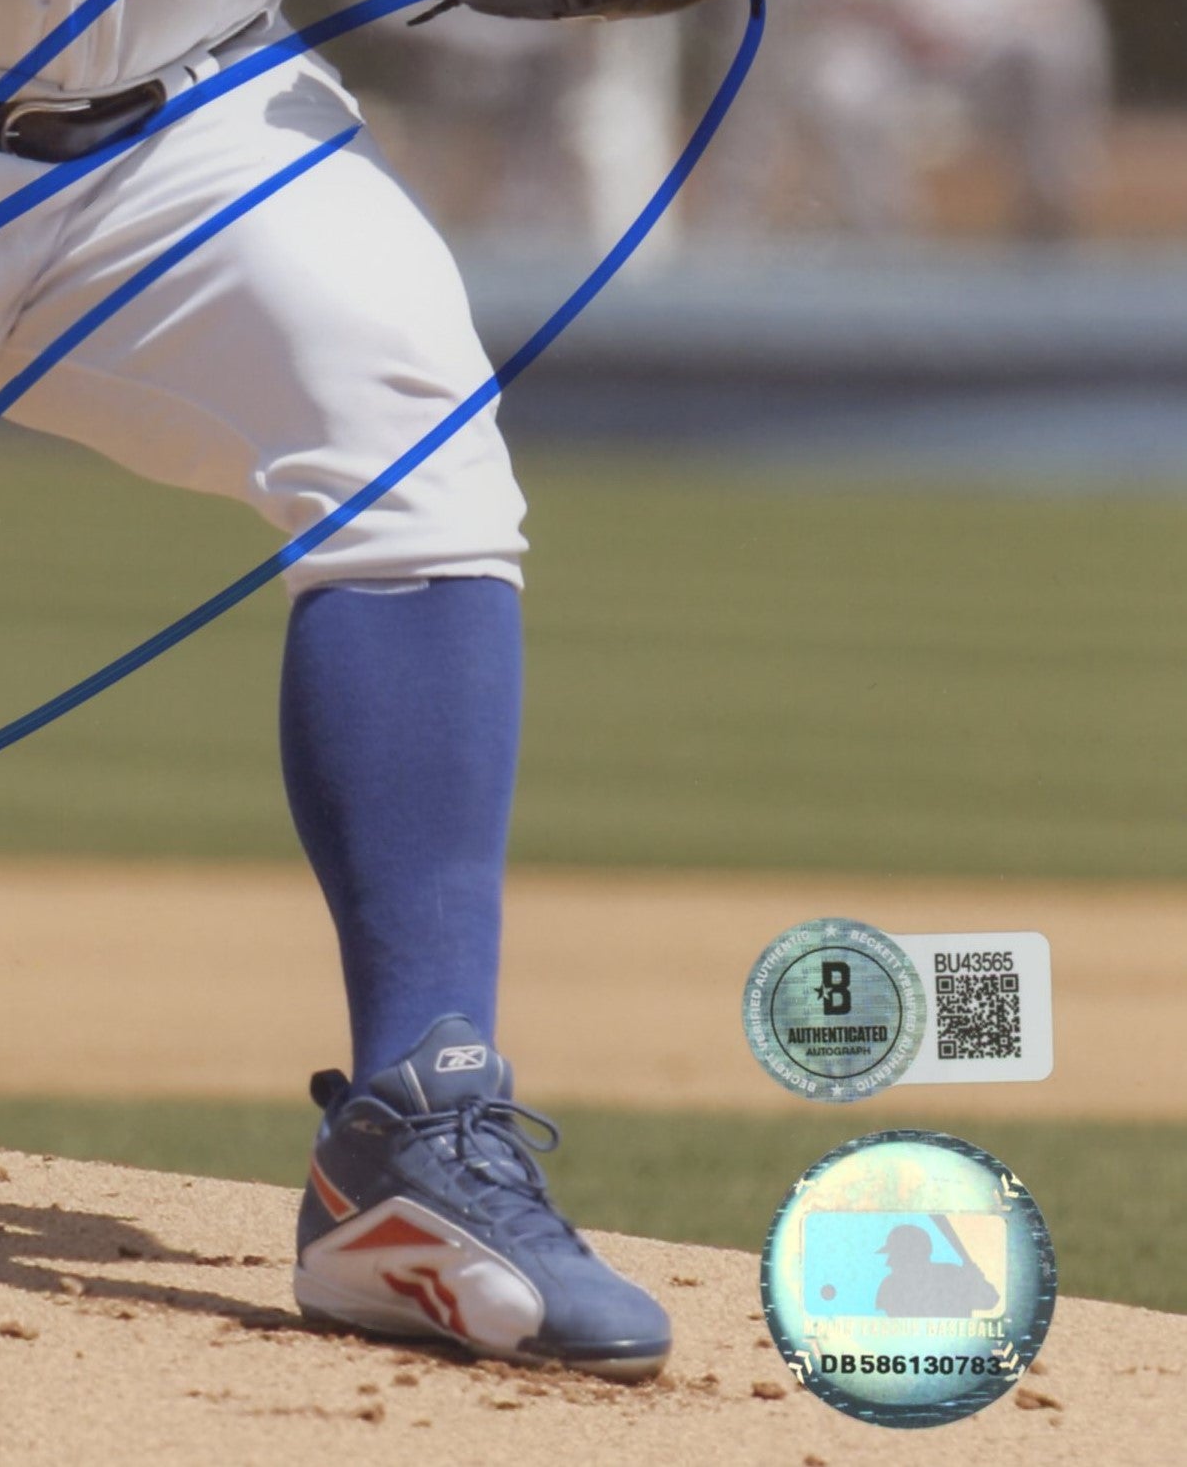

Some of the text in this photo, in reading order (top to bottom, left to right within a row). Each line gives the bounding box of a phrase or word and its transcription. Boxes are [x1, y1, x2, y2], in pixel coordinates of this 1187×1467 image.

[850, 930, 902, 969] BECKETT
[934, 951, 1014, 973] BU43565
[821, 961, 852, 1016] B
[750, 930, 817, 1093] BECKETT VERIFIED AUTHENTIC
[788, 1025, 888, 1044] AUTHENTICATED
[805, 1045, 872, 1056] AUTOGRAPH
[856, 1034, 913, 1092] AUTHENTIC
[925, 1320, 1006, 1338] BASEBALL
[820, 1354, 1003, 1376] DB586130783
